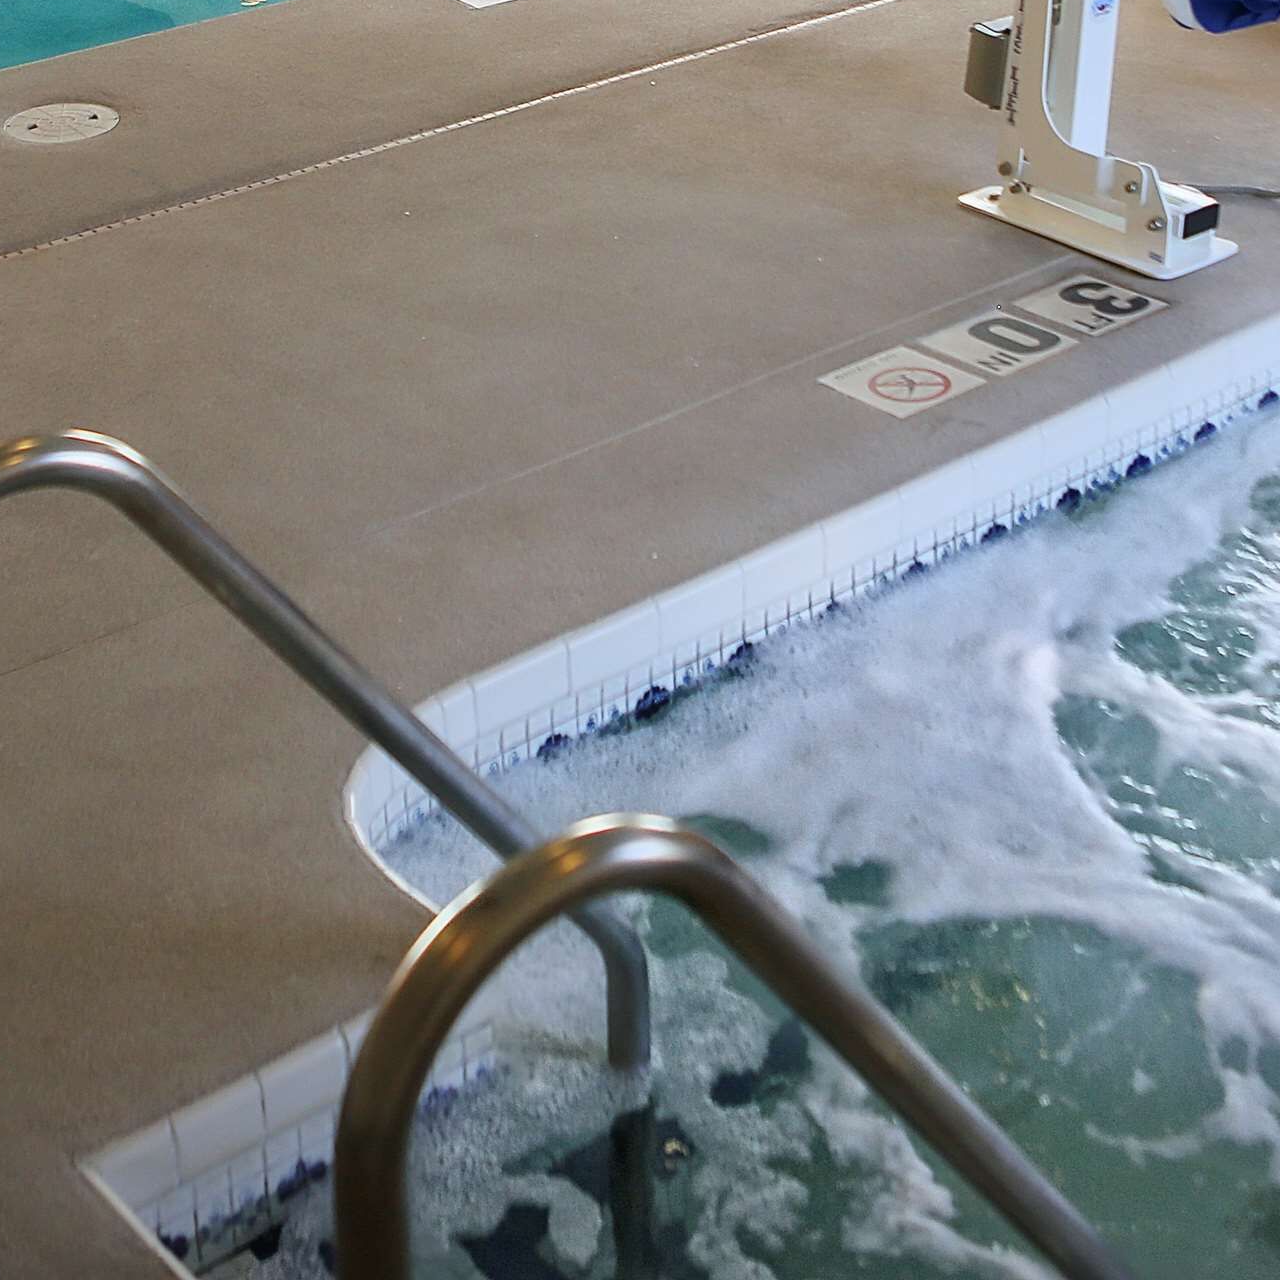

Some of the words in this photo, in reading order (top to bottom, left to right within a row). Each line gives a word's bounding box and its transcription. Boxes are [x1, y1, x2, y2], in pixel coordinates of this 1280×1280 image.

[1058, 282, 1150, 315] 3
[1074, 312, 1115, 330] FT
[968, 318, 1061, 355] 0
[977, 351, 1021, 371] IN
